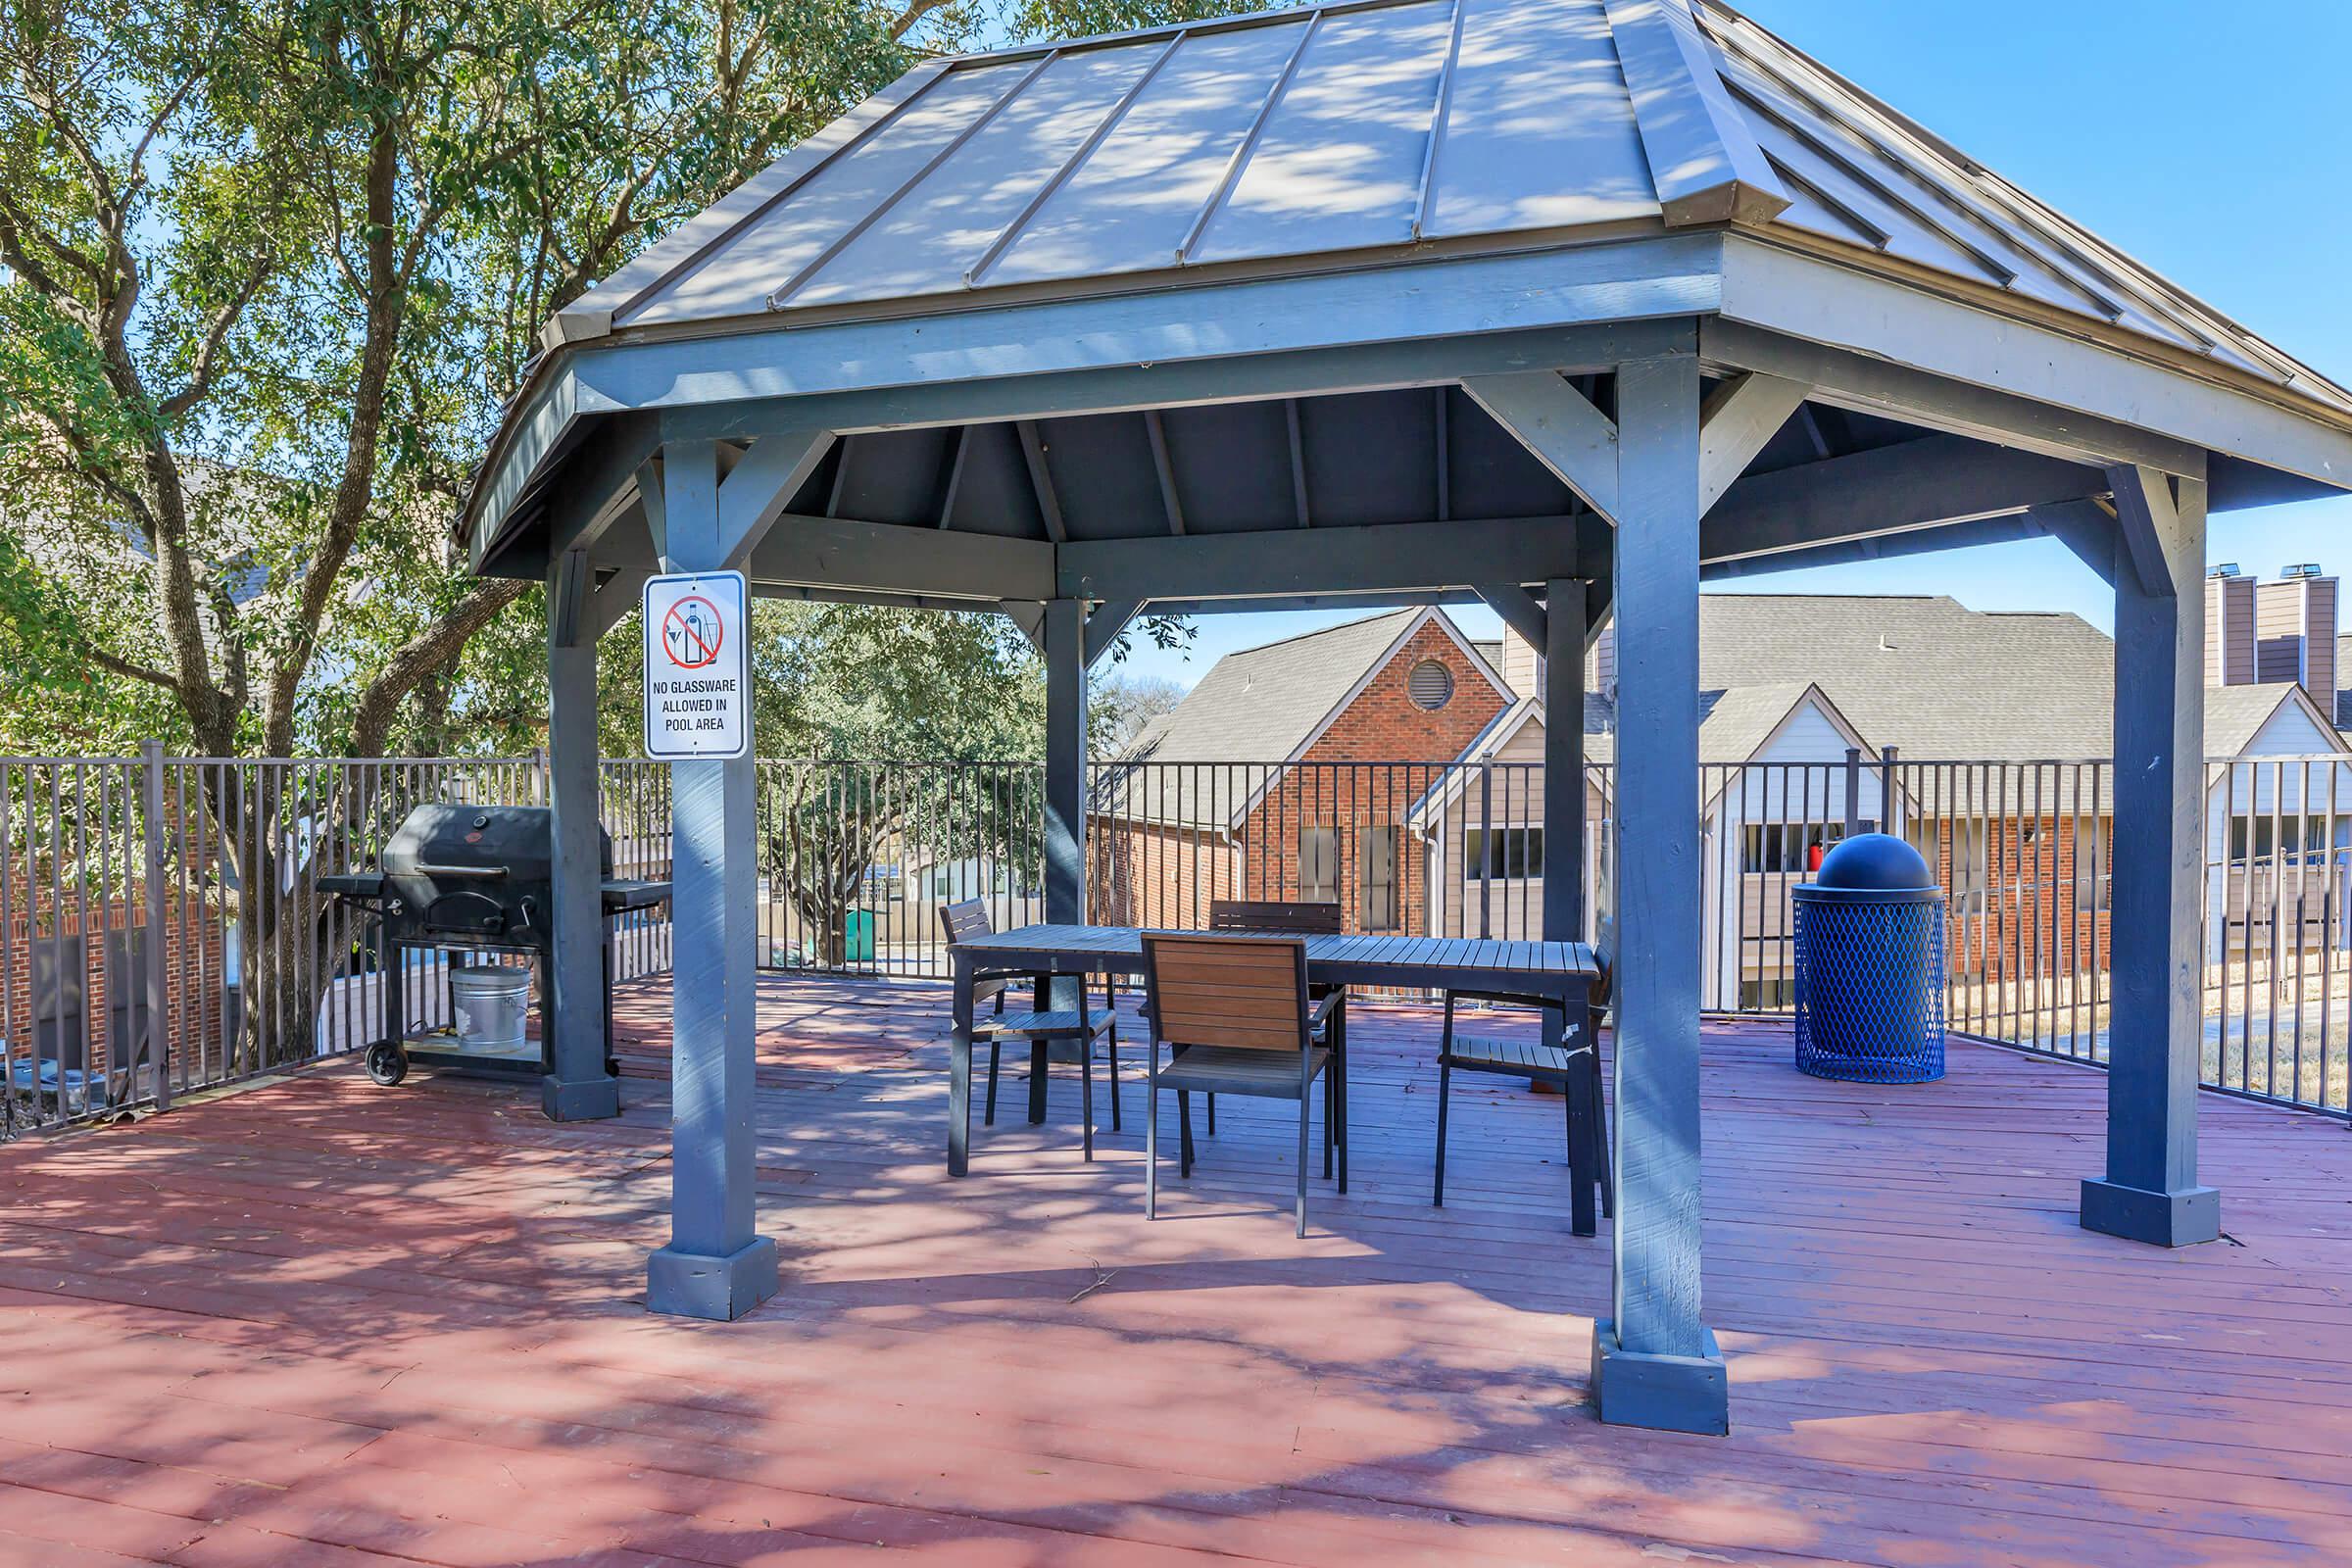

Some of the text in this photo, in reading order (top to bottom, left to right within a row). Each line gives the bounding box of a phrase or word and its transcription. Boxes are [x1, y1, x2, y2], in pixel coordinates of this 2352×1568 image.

[654, 679, 736, 694] NO GLASSWARE
[662, 699, 727, 712] ALLOWED IN
[665, 718, 724, 731] POOL AREA
